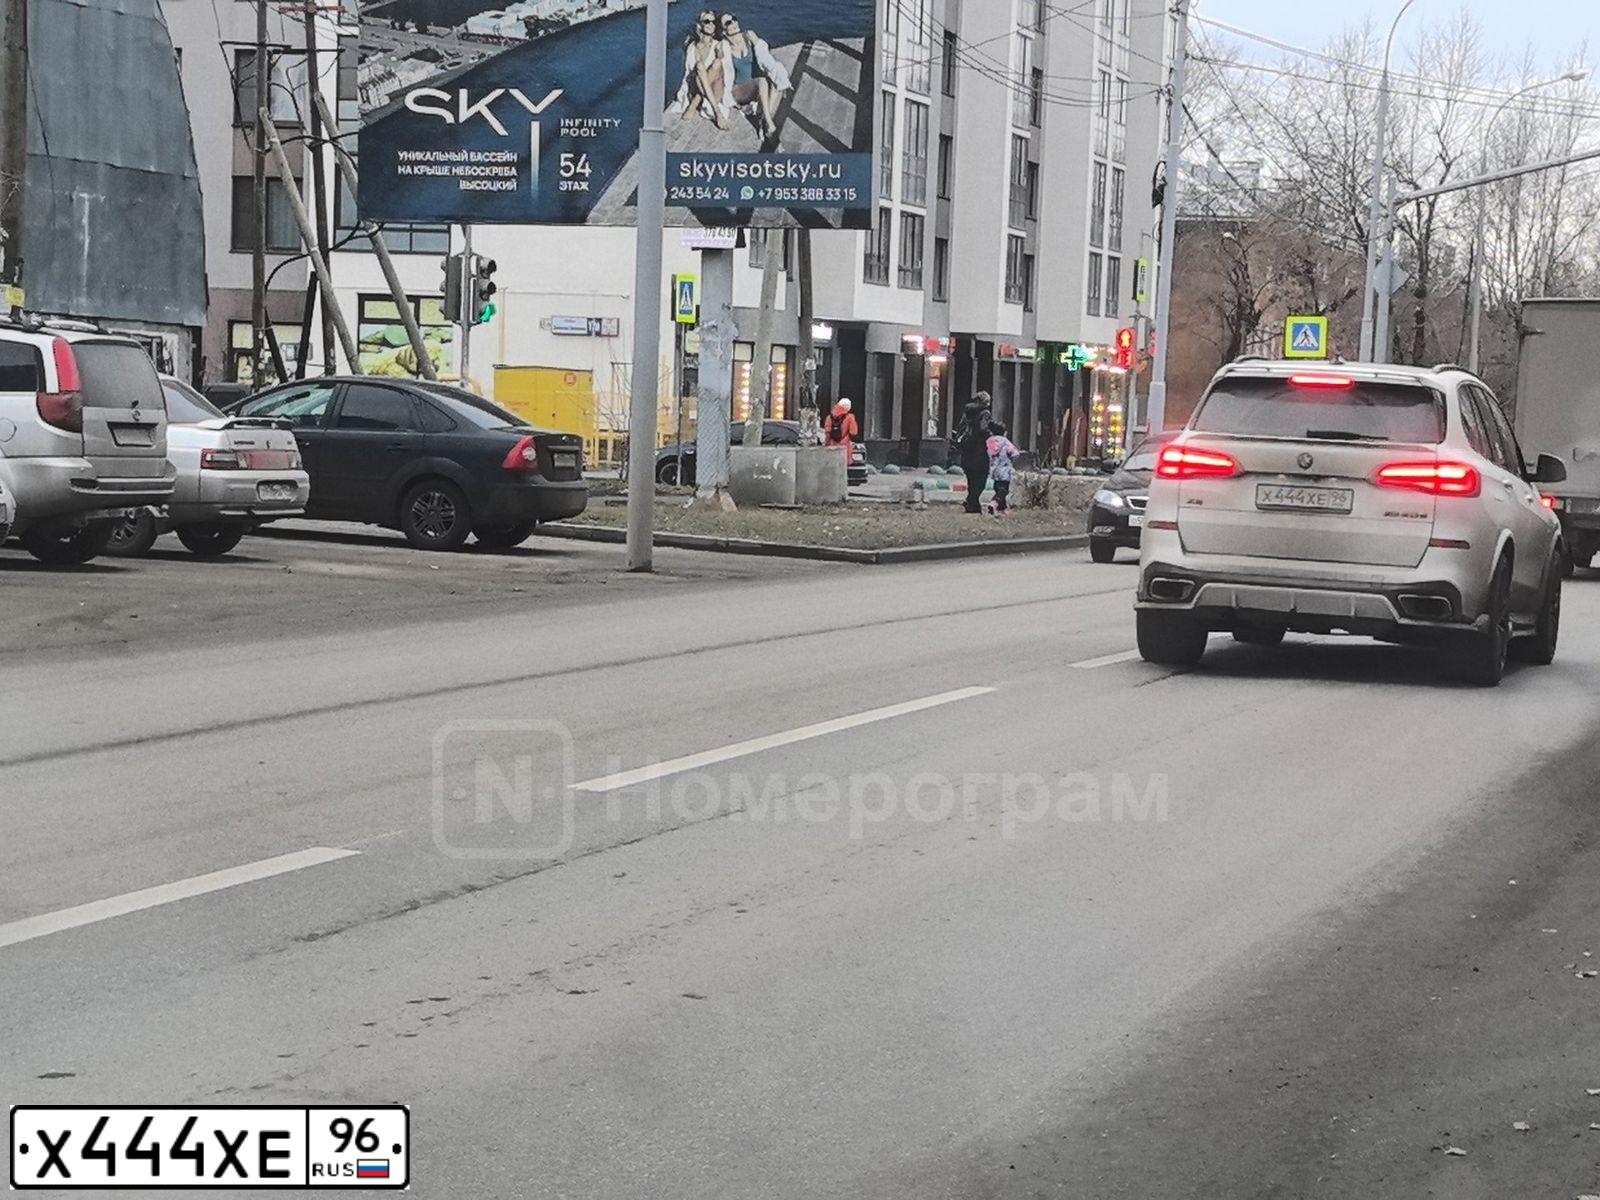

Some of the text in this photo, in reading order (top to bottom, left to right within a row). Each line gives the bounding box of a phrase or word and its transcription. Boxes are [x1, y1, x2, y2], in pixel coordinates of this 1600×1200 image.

[560, 118, 622, 128] INFINITY
[560, 127, 597, 137] POOL
[398, 150, 518, 162] УНИКАЛЬНЫЙ БАССЕЙН
[397, 165, 412, 175] НА
[413, 165, 450, 176] КРЫШЕ
[559, 153, 592, 178] 54
[679, 158, 842, 184] skyvisotsky.ru
[459, 178, 517, 192] ВЫСОЦКИЙ
[558, 180, 589, 192] ЭТАЖ
